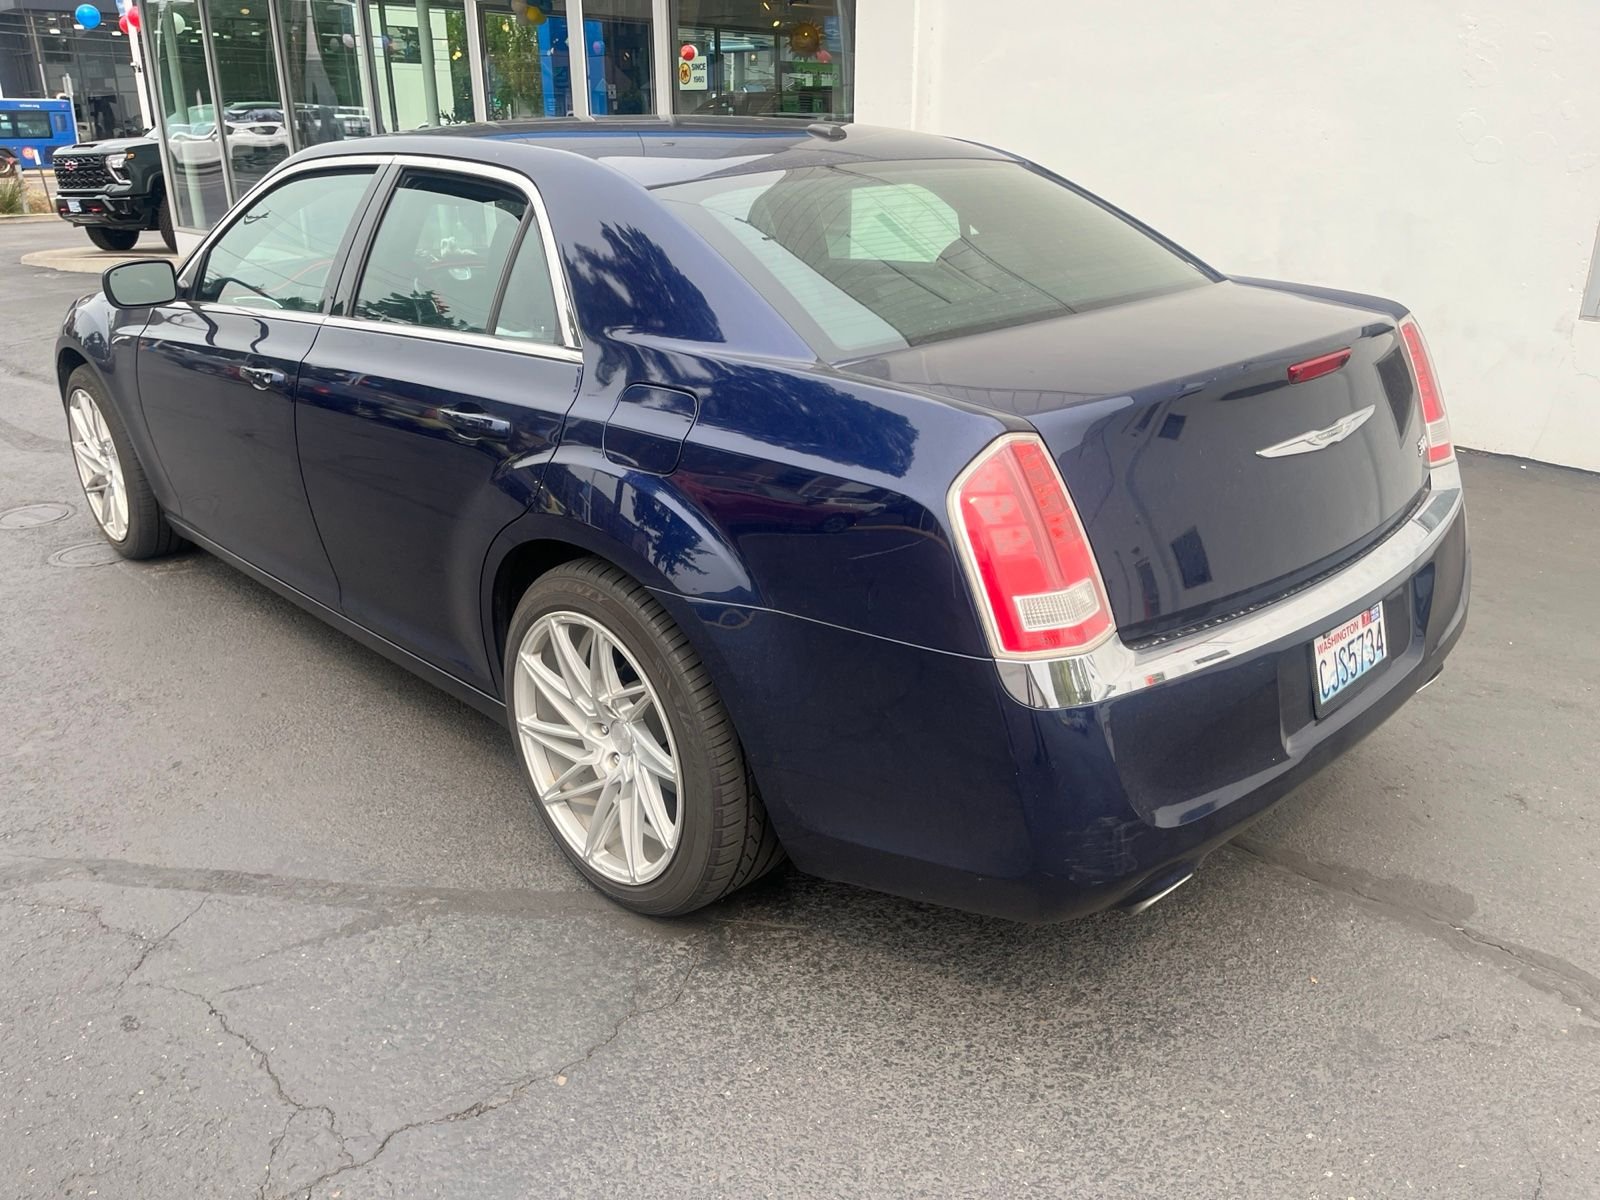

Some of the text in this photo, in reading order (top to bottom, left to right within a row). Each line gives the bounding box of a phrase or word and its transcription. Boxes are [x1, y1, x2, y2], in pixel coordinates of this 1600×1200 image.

[691, 63, 706, 71] SINCE
[1317, 621, 1359, 655] WASHINGTON
[1320, 622, 1384, 698] CJS5734
